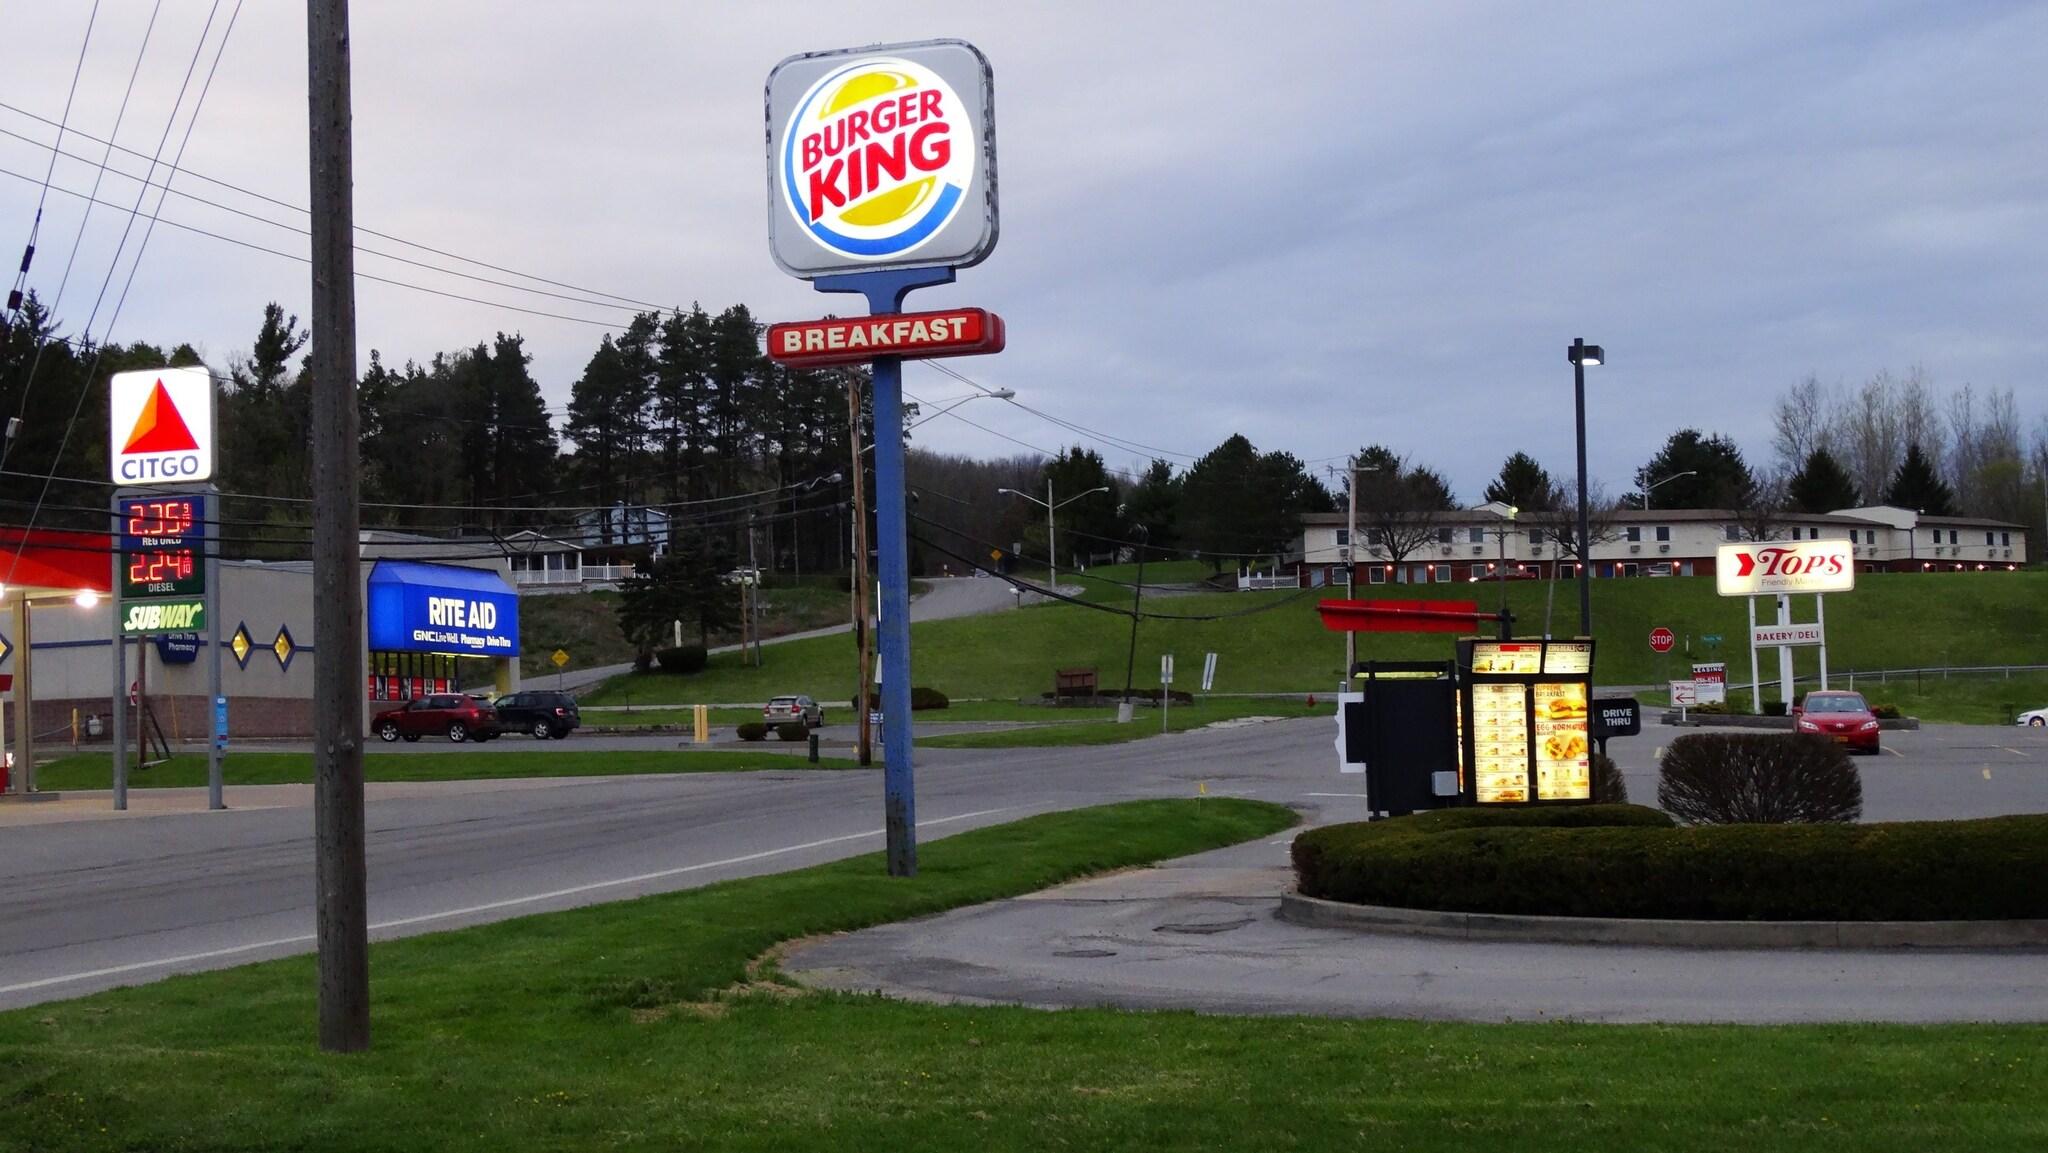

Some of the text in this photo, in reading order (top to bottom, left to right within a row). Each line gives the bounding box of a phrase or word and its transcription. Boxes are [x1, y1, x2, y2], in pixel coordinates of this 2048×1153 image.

[802, 89, 943, 173] BURGER
[809, 121, 951, 222] KING
[784, 317, 967, 353] BREAKFAST
[121, 455, 199, 480] CITGO
[148, 582, 175, 592] DIESEL
[123, 602, 203, 631] SUBWAY
[429, 597, 496, 629] RITE AID
[168, 642, 196, 653] Pharmacy
[413, 629, 436, 642] GNC
[461, 633, 485, 648] Pharmacy
[1651, 635, 1673, 645] STOP
[1602, 708, 1633, 718] DRIVE
[1605, 717, 1631, 727] THRU
